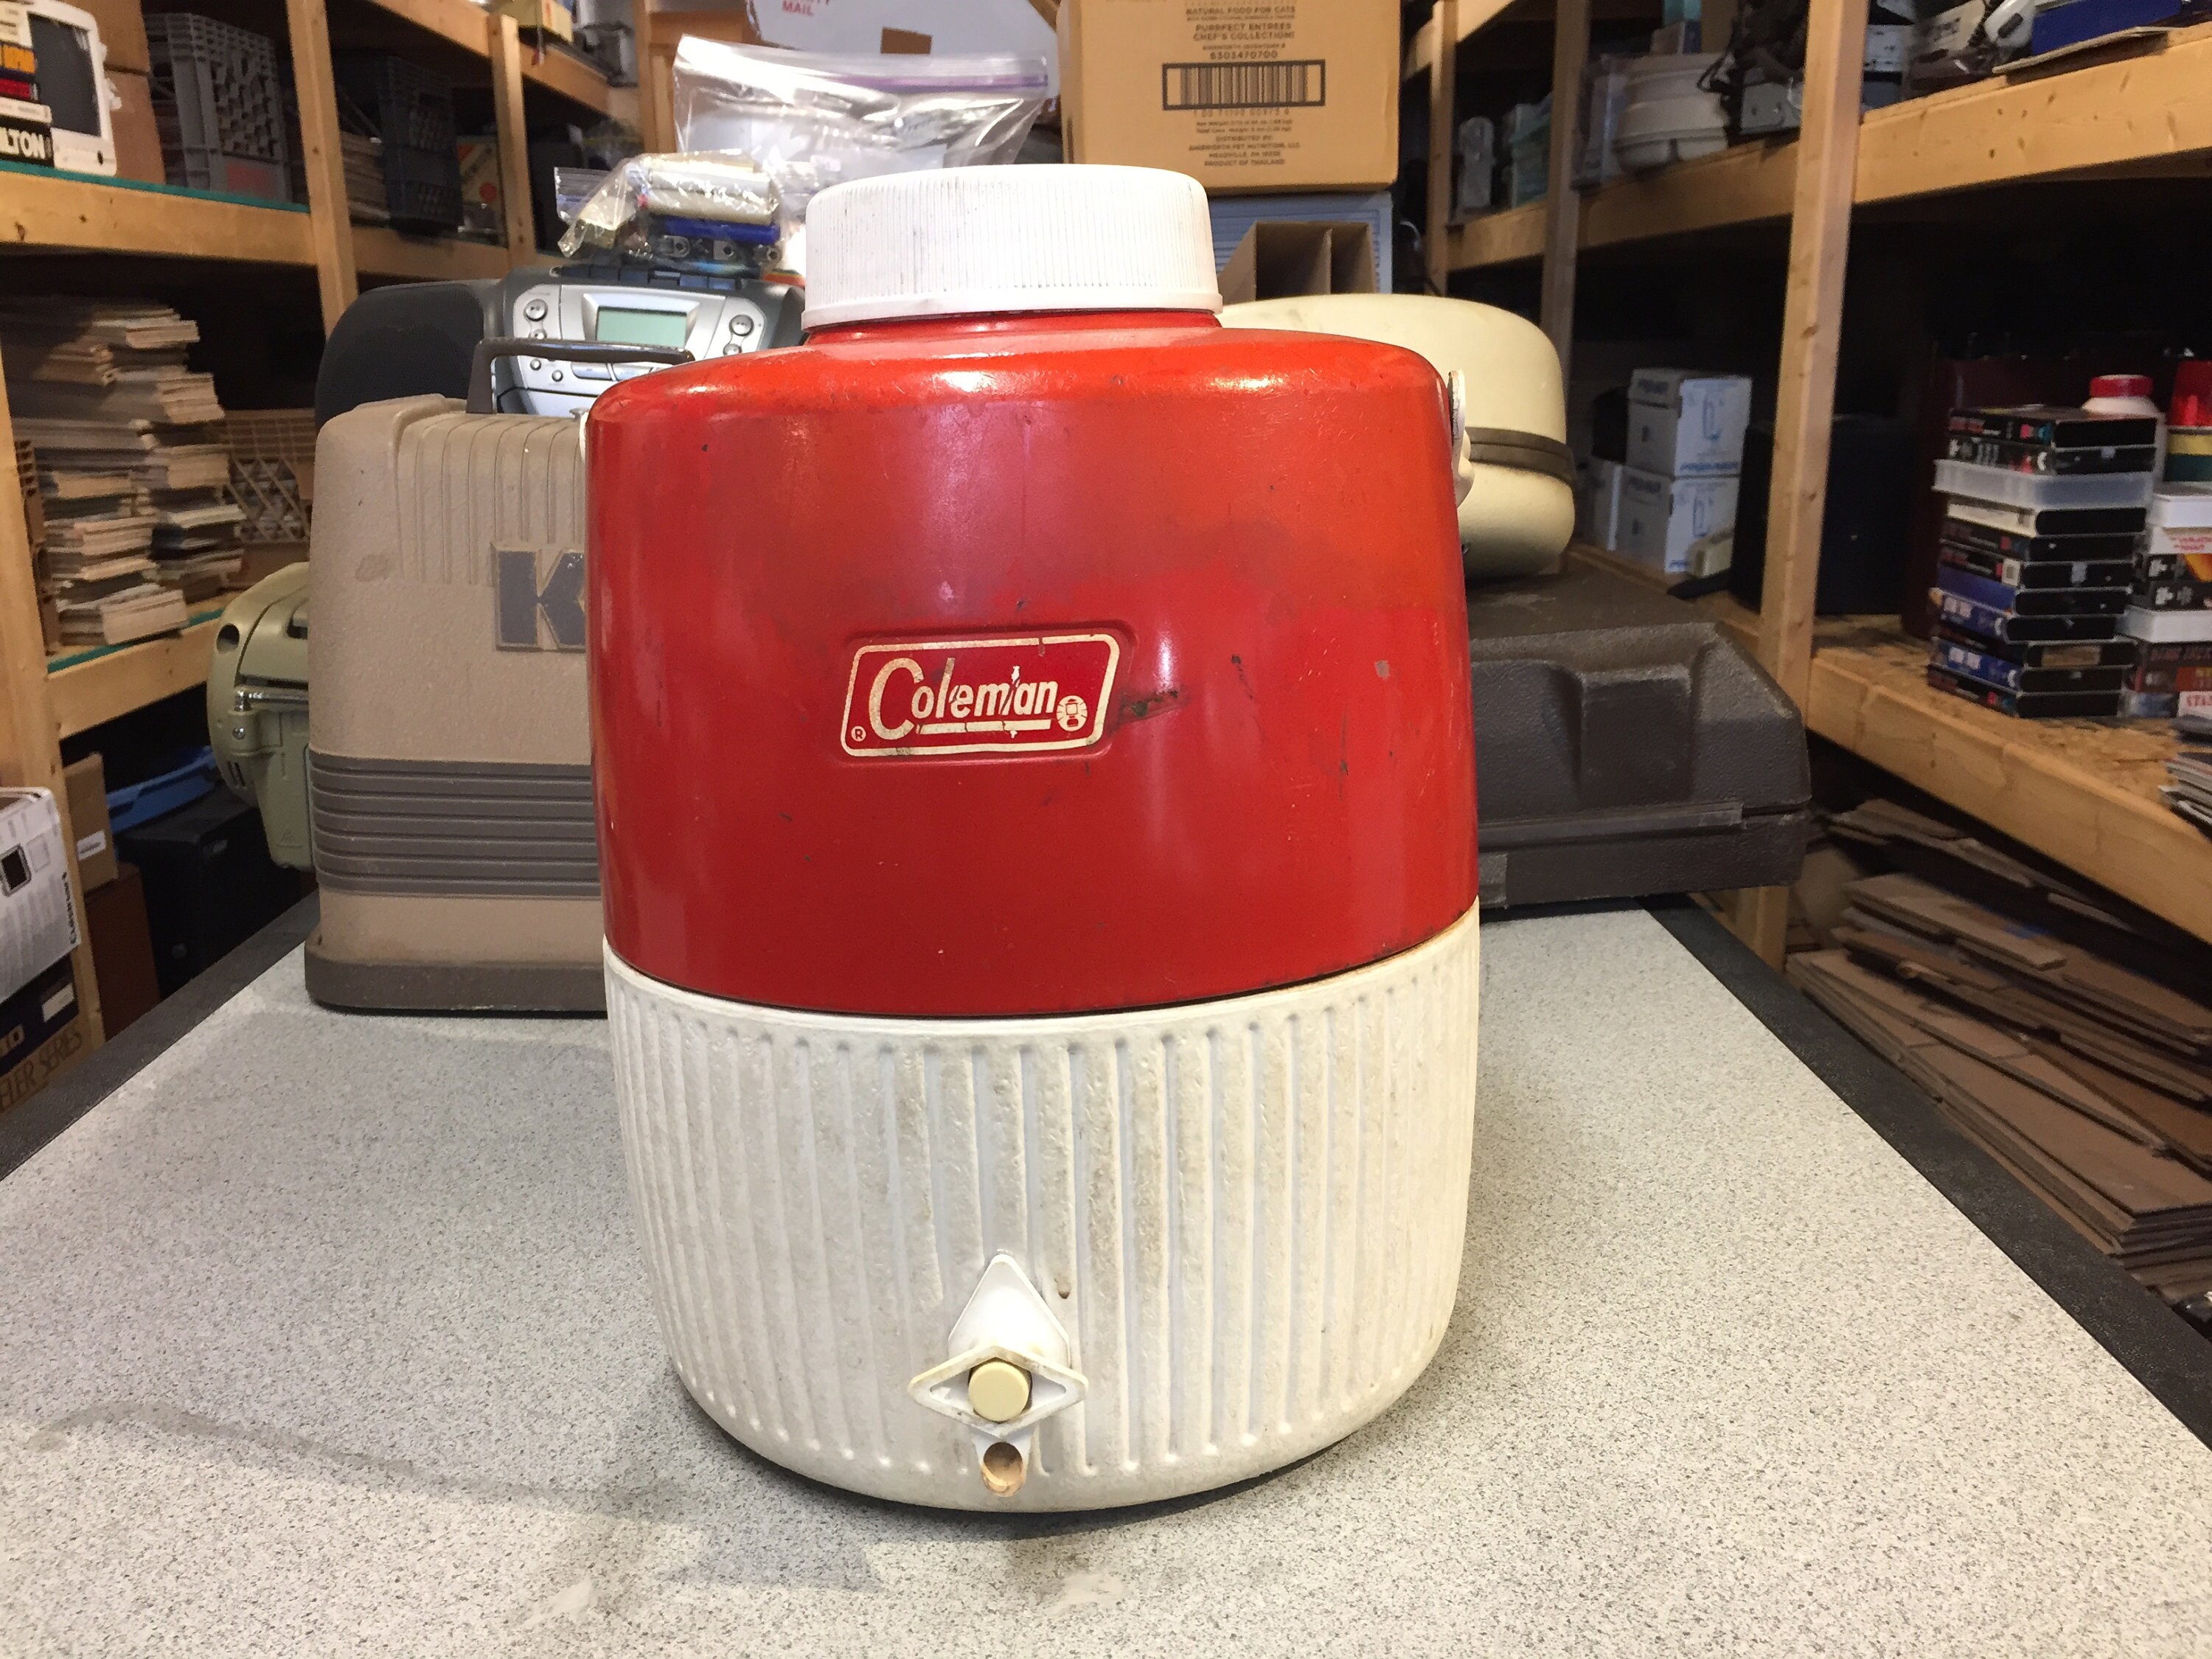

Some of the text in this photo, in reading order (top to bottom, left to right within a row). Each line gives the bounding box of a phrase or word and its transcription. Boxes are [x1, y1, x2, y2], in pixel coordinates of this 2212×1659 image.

[782, 1, 814, 16] MAIL
[1274, 5, 1295, 13] CATS
[1195, 23, 1245, 32] PURRFECT
[869, 658, 1059, 740] Coleman
